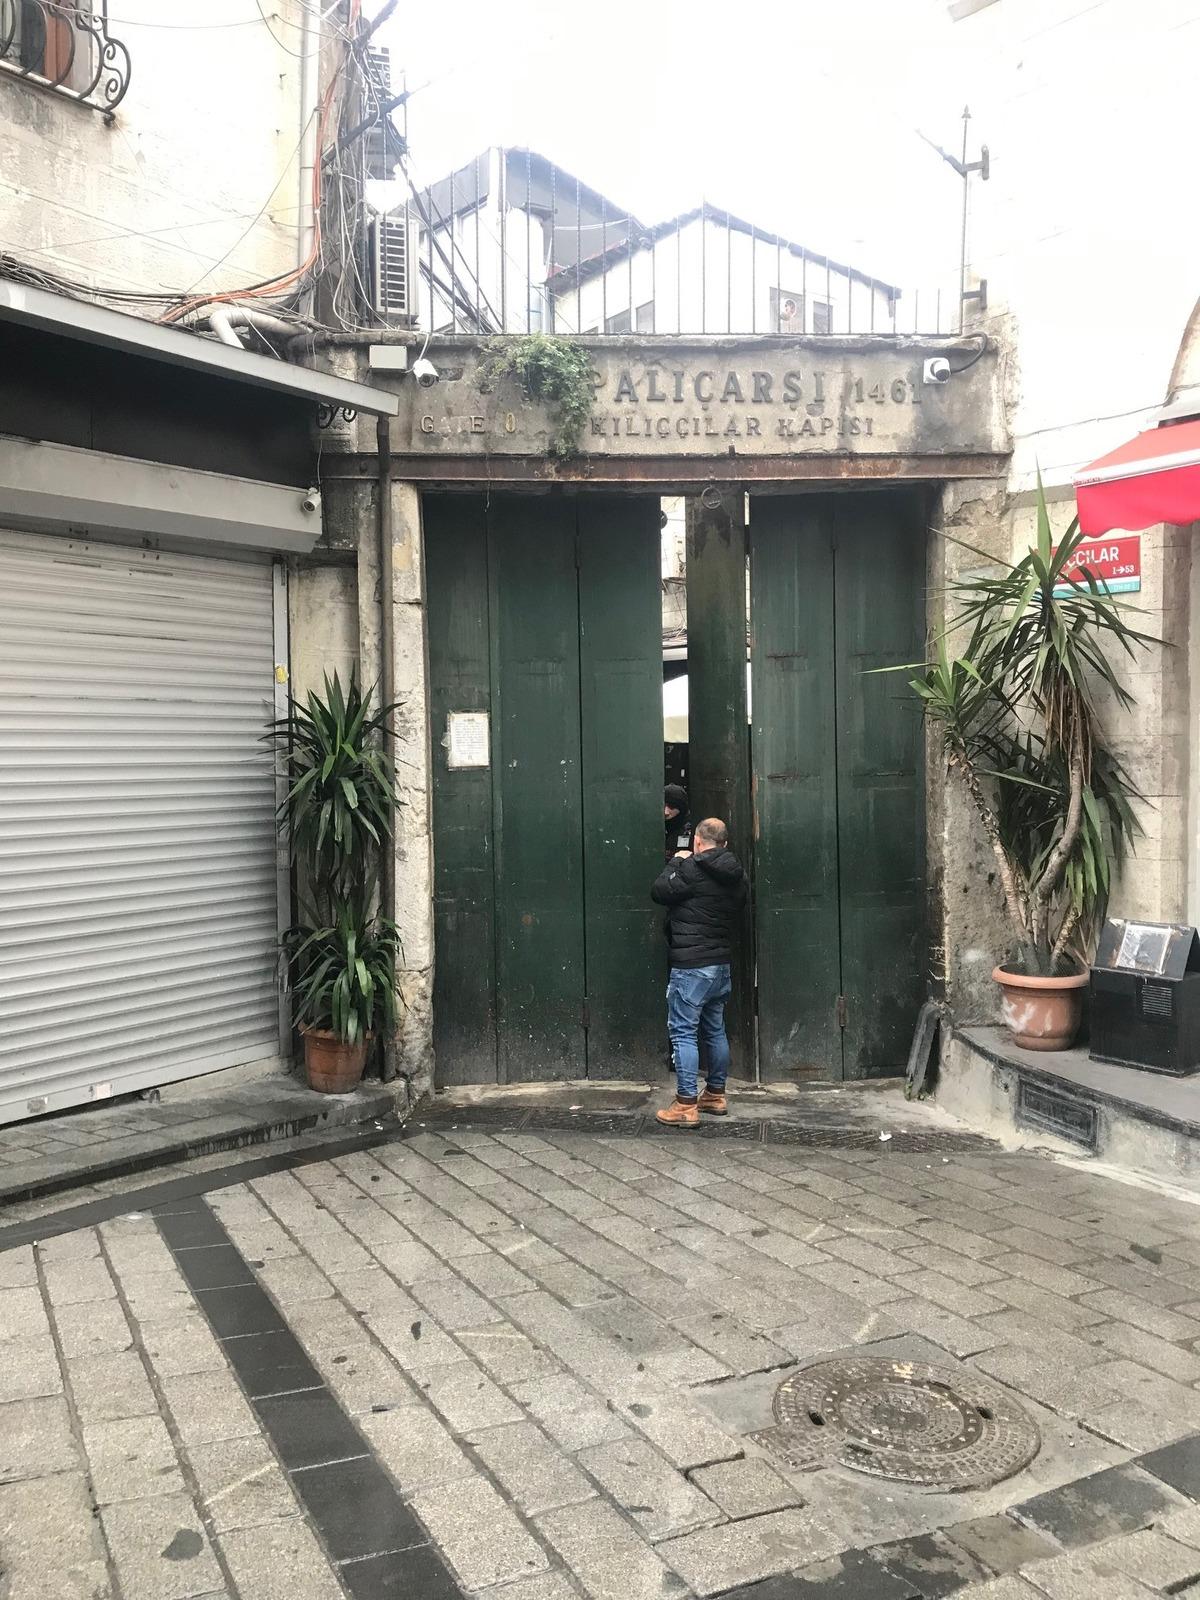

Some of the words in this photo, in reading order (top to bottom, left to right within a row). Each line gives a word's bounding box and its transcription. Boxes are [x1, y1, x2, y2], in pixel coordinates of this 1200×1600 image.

[591, 370, 825, 411] PALIÇARŞI
[855, 377, 922, 404] 1461
[777, 417, 874, 437] KAPISI
